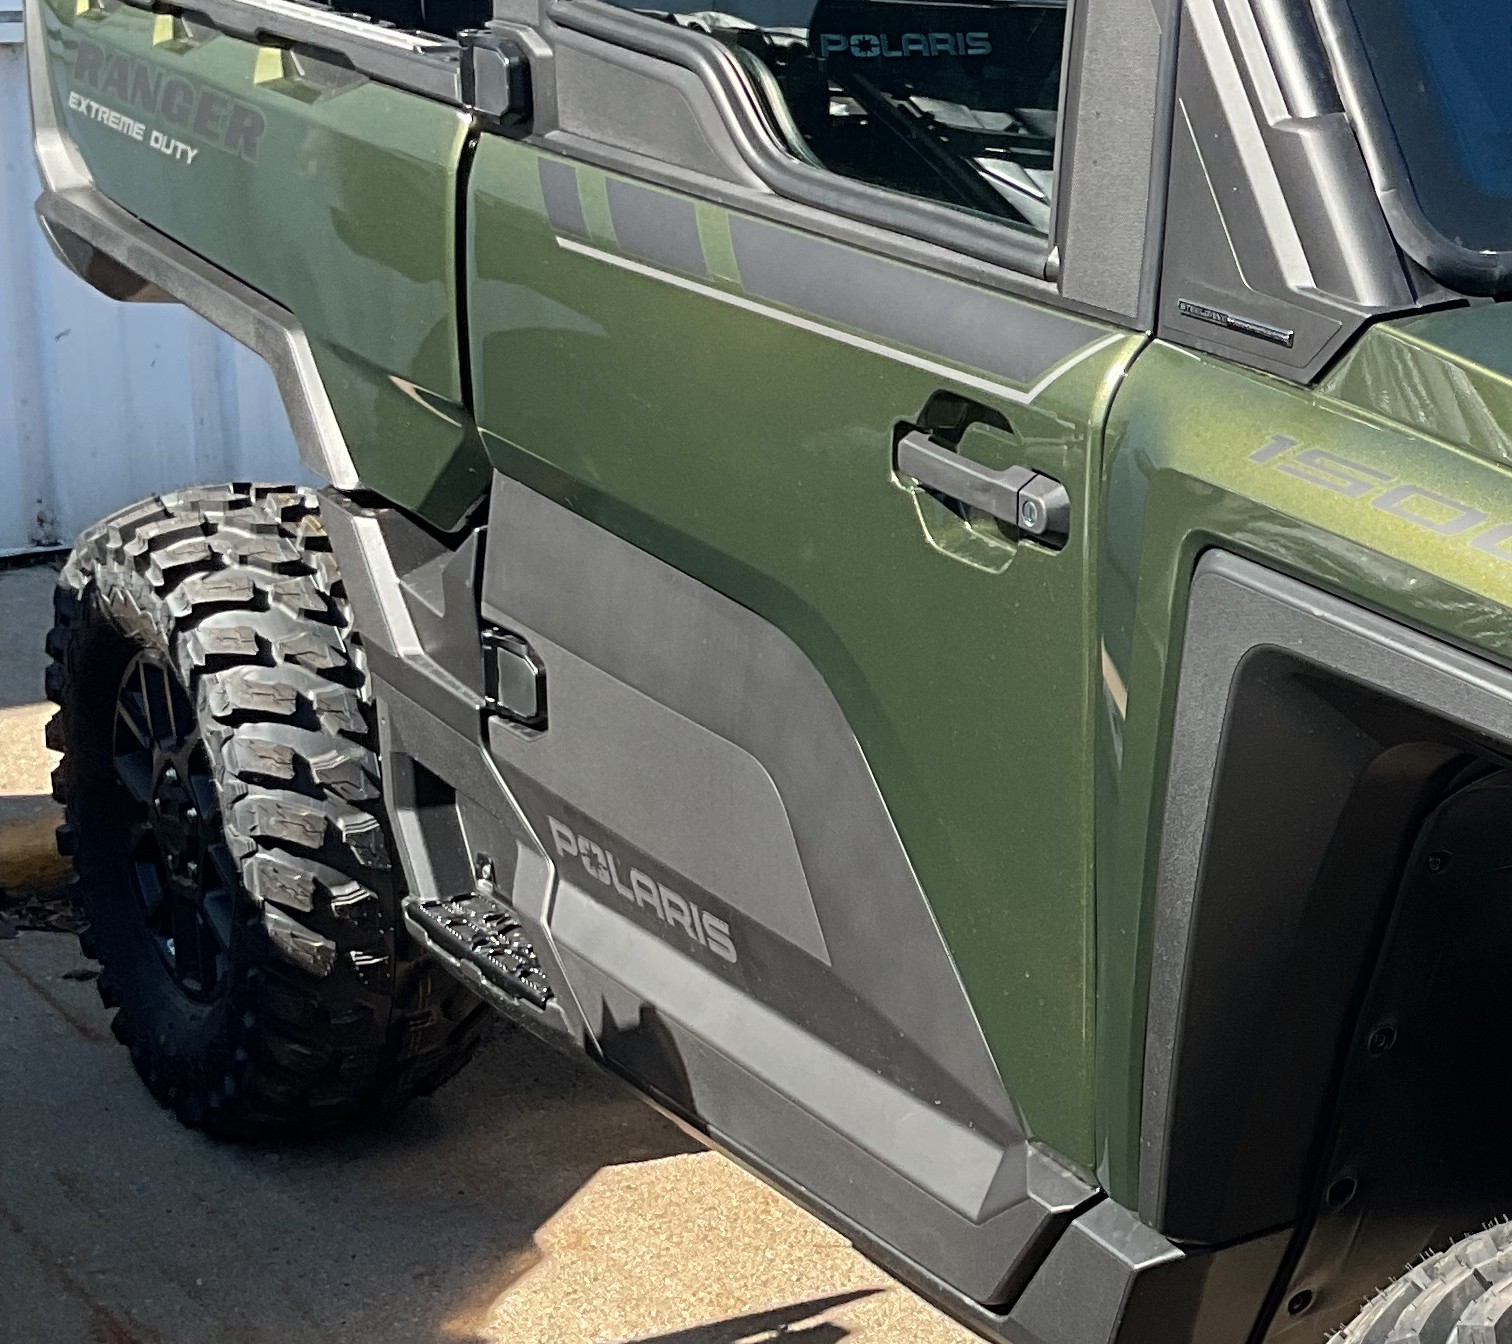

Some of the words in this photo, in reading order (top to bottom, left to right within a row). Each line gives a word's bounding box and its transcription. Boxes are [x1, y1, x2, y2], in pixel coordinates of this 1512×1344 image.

[820, 32, 992, 60] POLARIS
[68, 91, 146, 142] EXTREME
[149, 130, 199, 165] DUTY
[74, 40, 266, 164] RANGER
[547, 815, 738, 964] POLARIS
